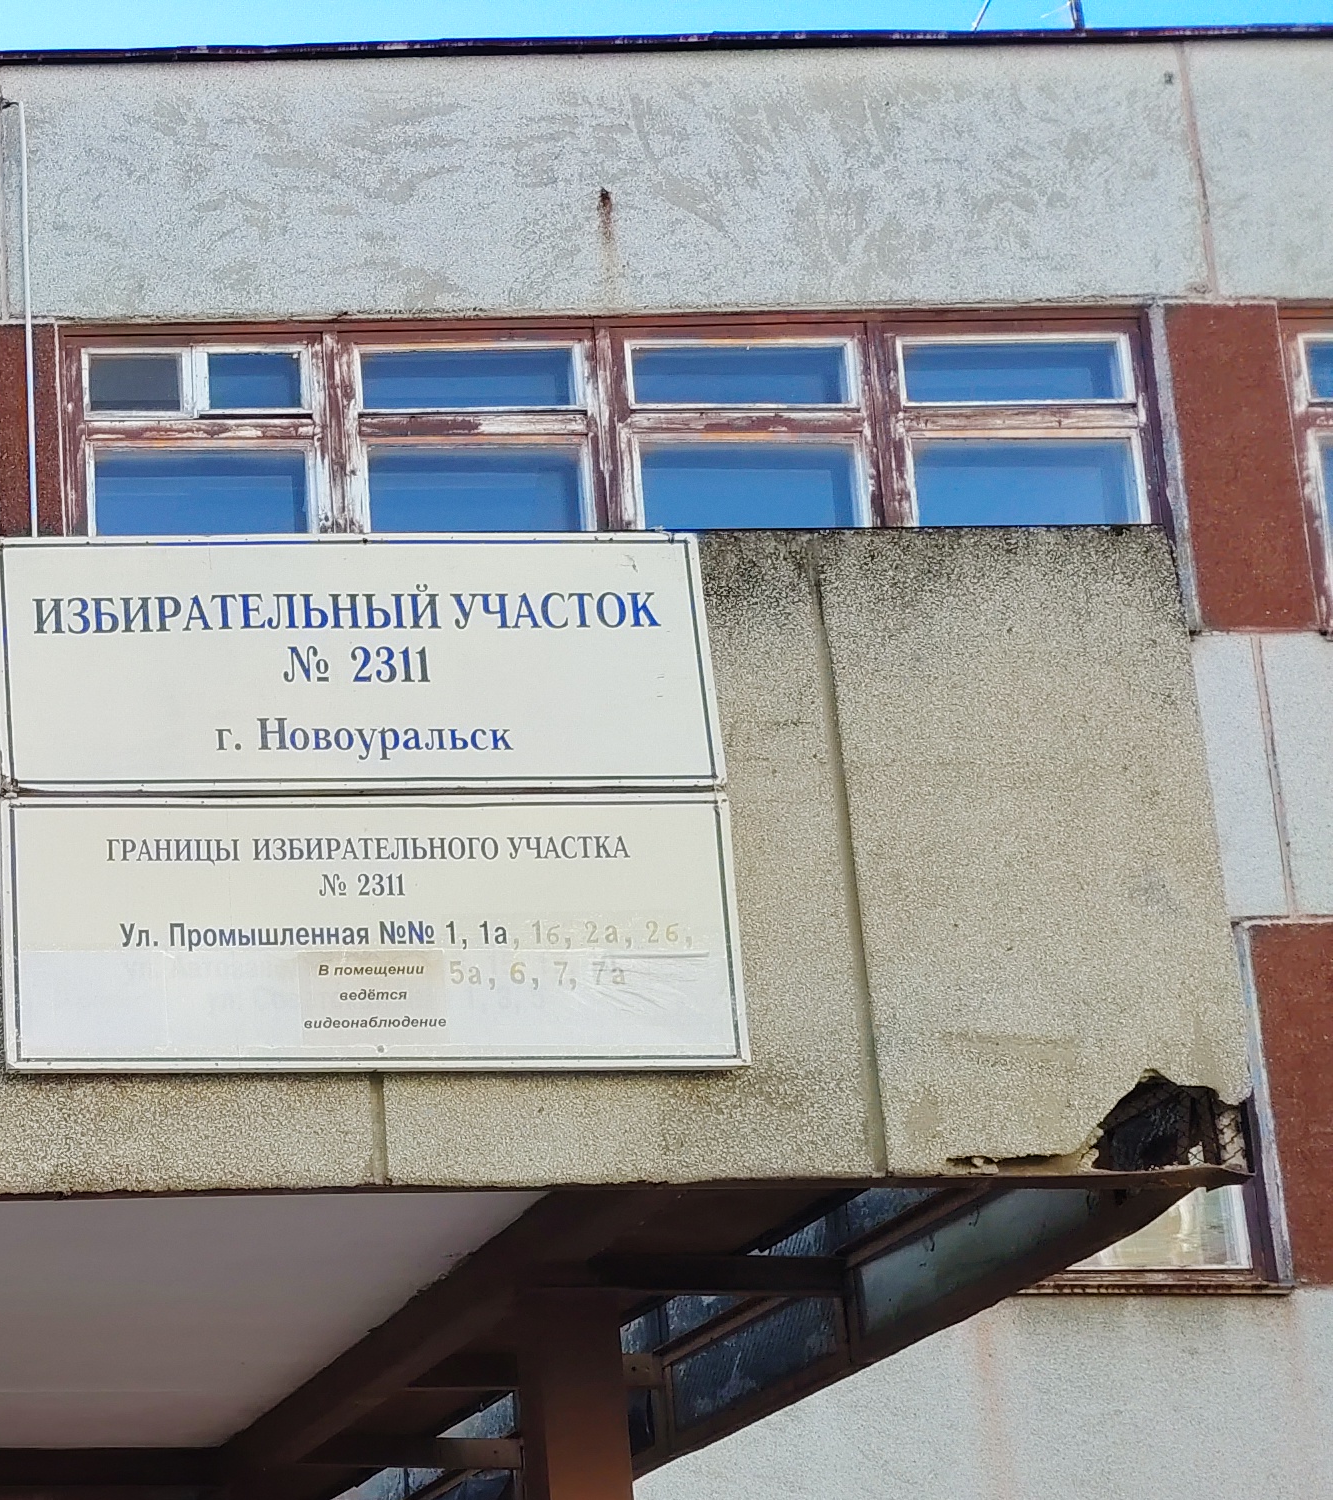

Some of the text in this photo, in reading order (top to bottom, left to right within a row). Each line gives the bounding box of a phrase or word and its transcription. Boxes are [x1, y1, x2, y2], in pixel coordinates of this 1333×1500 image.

[33, 584, 661, 635] ИЗБИРАТЕЛЬНЫЙ УЧАСТОК
[283, 645, 431, 683] № 2311
[215, 717, 514, 761] г. Новоуральск
[106, 834, 631, 865] ГРАНИЦЫ ИЗБИРАТЕЛЬНОГО УЧАСТКА
[318, 873, 406, 897] № 2311
[119, 922, 160, 947] Ул.
[169, 922, 370, 952] Промышленная
[379, 920, 435, 945] №№
[445, 920, 468, 950] 1,
[318, 964, 425, 977] В помещении
[339, 988, 408, 1001] ведётся
[303, 1015, 447, 1029] видеонаблюдение
